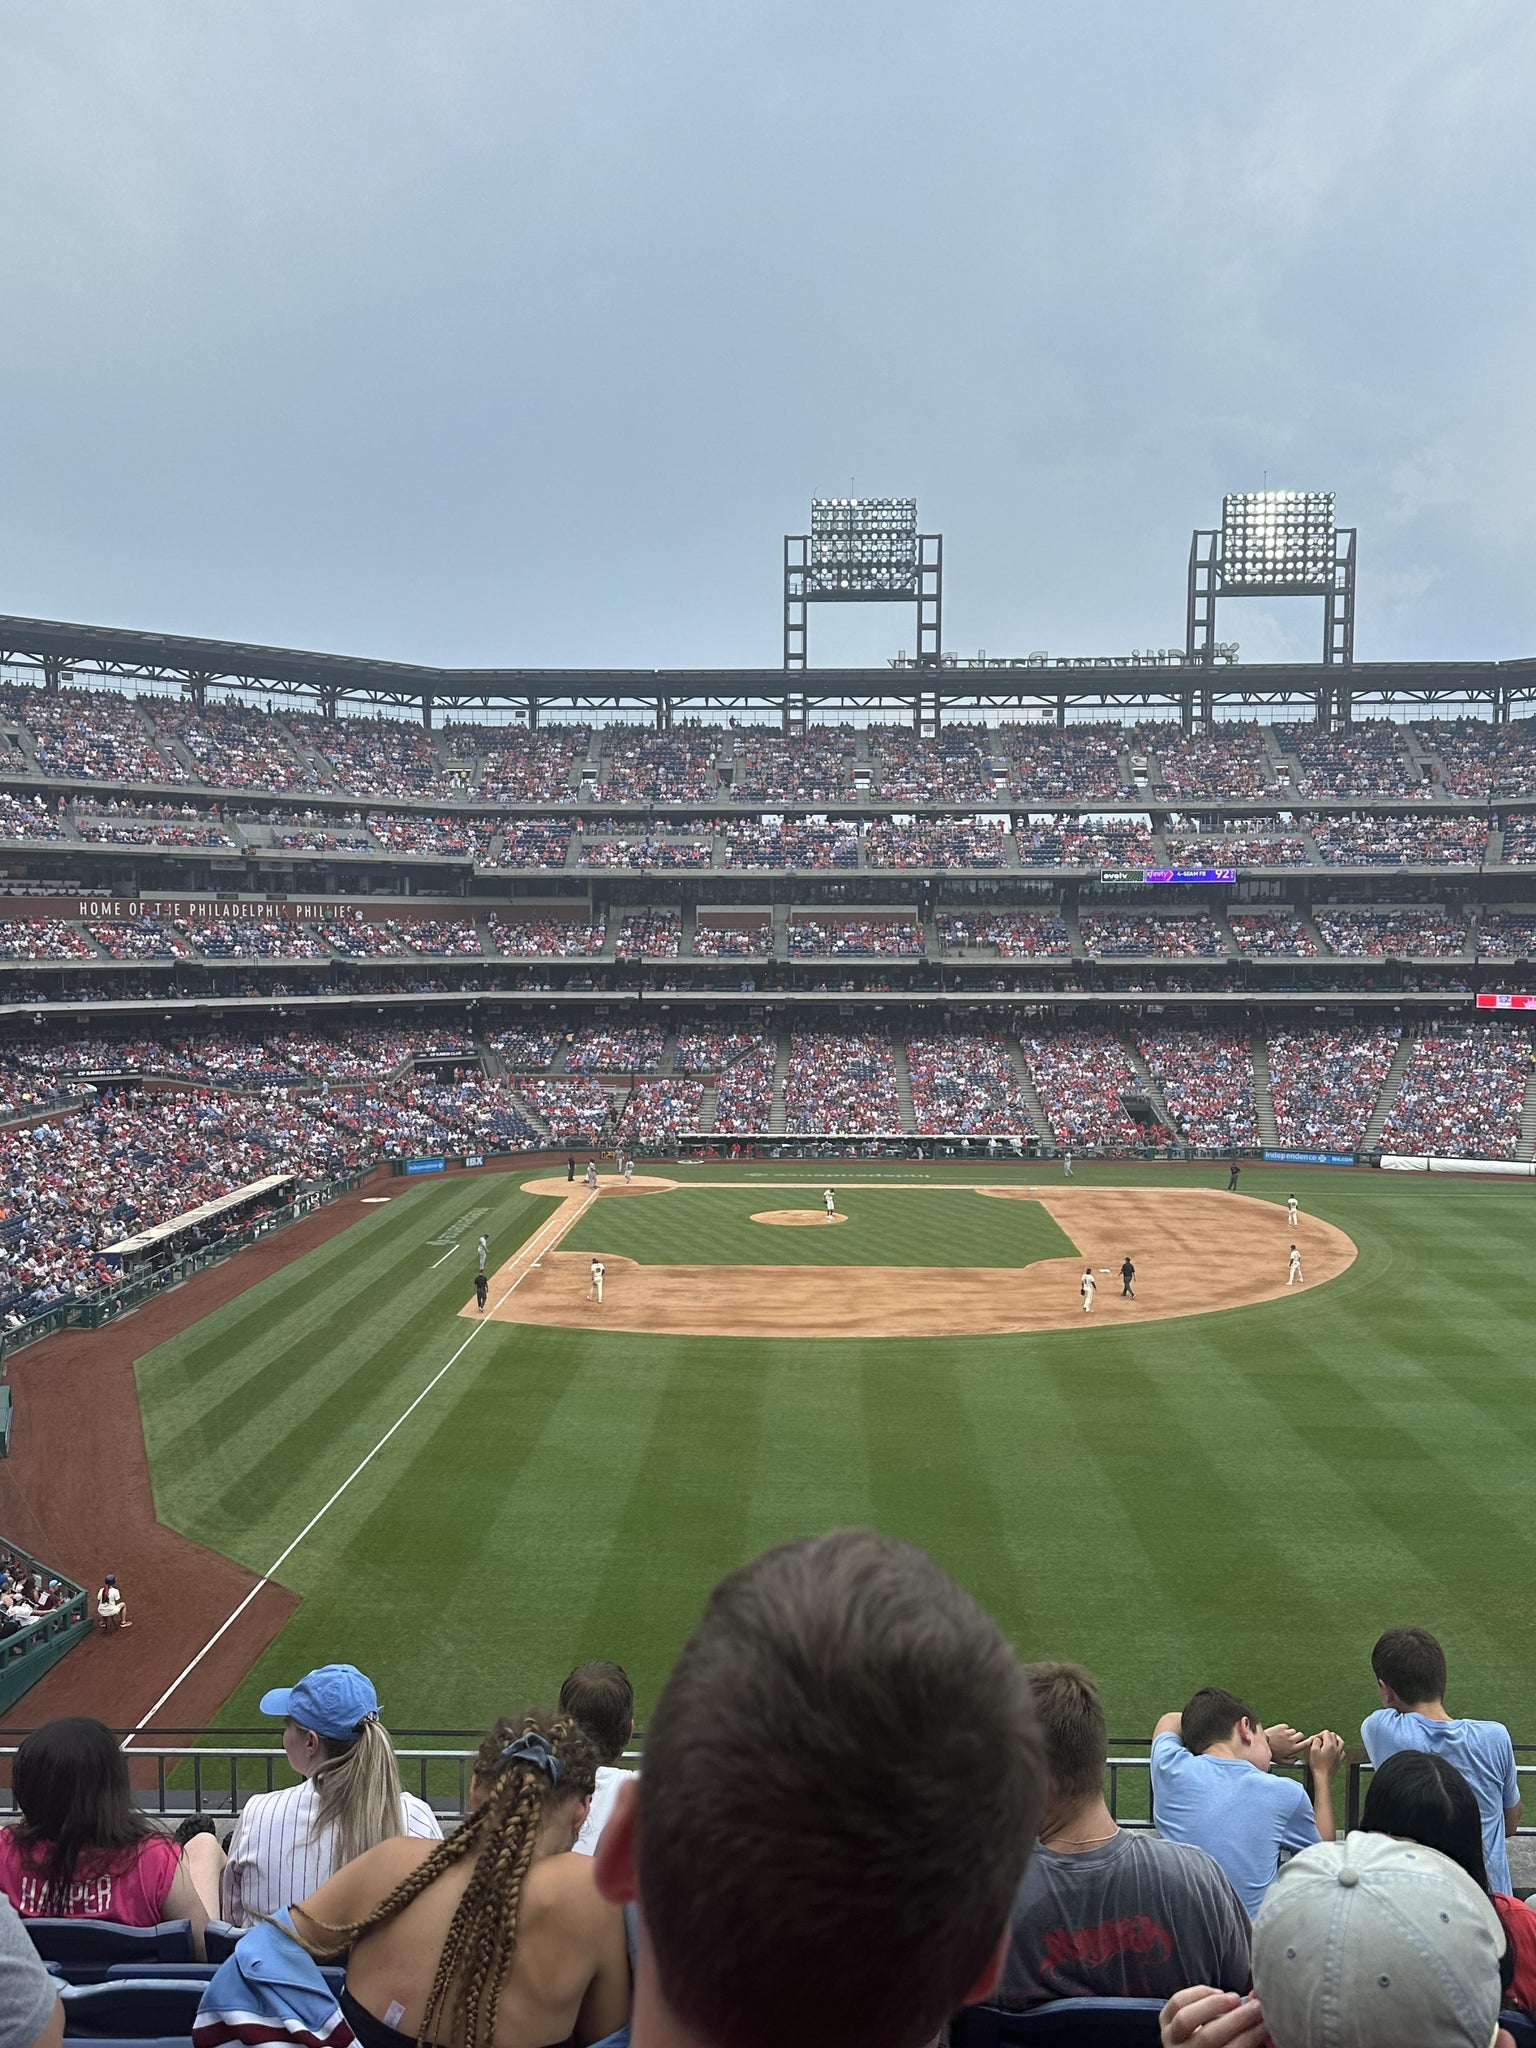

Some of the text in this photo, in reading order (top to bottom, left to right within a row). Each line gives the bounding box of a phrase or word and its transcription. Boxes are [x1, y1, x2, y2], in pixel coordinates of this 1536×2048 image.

[1215, 869, 1229, 879] 92
[79, 902, 121, 917] HOME
[129, 902, 145, 916] OF
[296, 905, 353, 919] PHILIES
[1265, 1151, 1317, 1161] Independence
[465, 1156, 485, 1168] IBX
